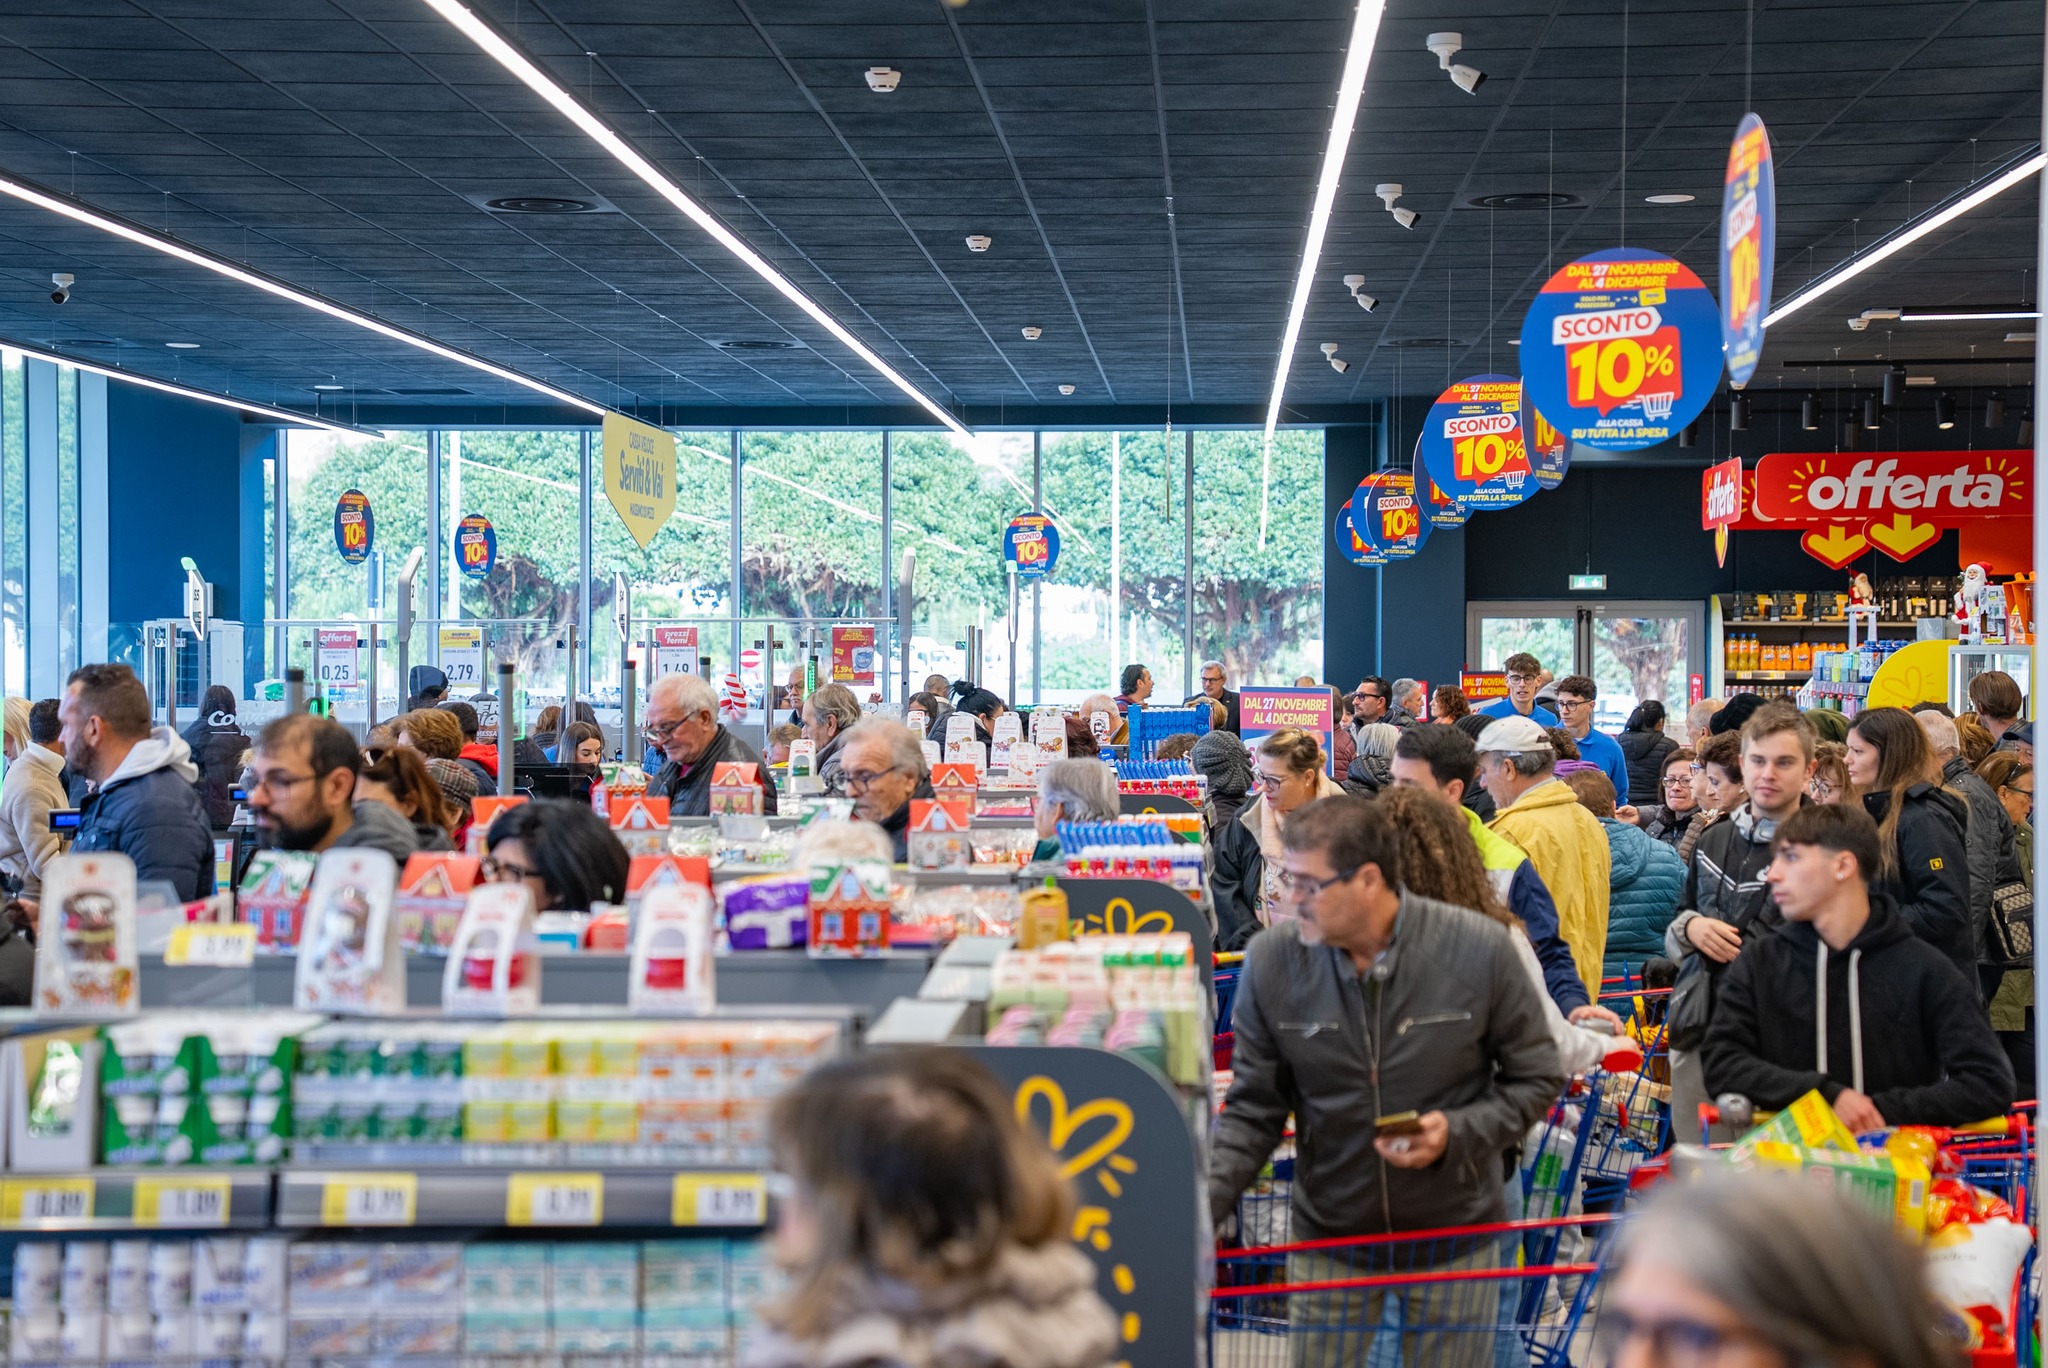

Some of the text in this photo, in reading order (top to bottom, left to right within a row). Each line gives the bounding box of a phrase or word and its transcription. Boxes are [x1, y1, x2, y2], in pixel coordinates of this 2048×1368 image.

[1567, 262, 1680, 277] DAL 27 NOVEMBRE
[1578, 275, 1668, 289] AL 4 DICEMBRE
[1730, 234, 1760, 321] 10%
[1561, 311, 1652, 338] SCONTO
[1570, 338, 1674, 401] 10%
[1452, 383, 1521, 392] DAL 27 NOVEMBR
[1460, 393, 1471, 401] AL
[1478, 392, 1520, 400] DICEMBRE
[1449, 416, 1511, 434] SCONTO
[1535, 410, 1555, 447] 10
[1595, 419, 1644, 428] ALLA CASSA
[1571, 427, 1669, 439] SU TUTTA LA SPESA
[1456, 434, 1525, 476] 10%
[619, 449, 664, 499] Serviti & Vai
[1807, 459, 2004, 510] offerta
[1708, 470, 1735, 520] offerta
[1380, 498, 1410, 508] SCONTO
[342, 513, 361, 522] SCONTO
[1383, 509, 1417, 537] 10%
[344, 523, 366, 546] 10%
[463, 535, 482, 543] SCONTO
[1014, 533, 1040, 541] SCONTO
[465, 543, 487, 563] 10%
[1017, 542, 1047, 562] 10%
[320, 633, 352, 642] offerta
[665, 631, 688, 639] prezzi
[447, 664, 474, 681] 2,79
[1464, 678, 1475, 686] DAL
[1469, 688, 1477, 696] AL
[1244, 697, 1327, 711] DAL 27 NOVEMBRE
[1252, 712, 1319, 726] AL 4 DICEMBRE
